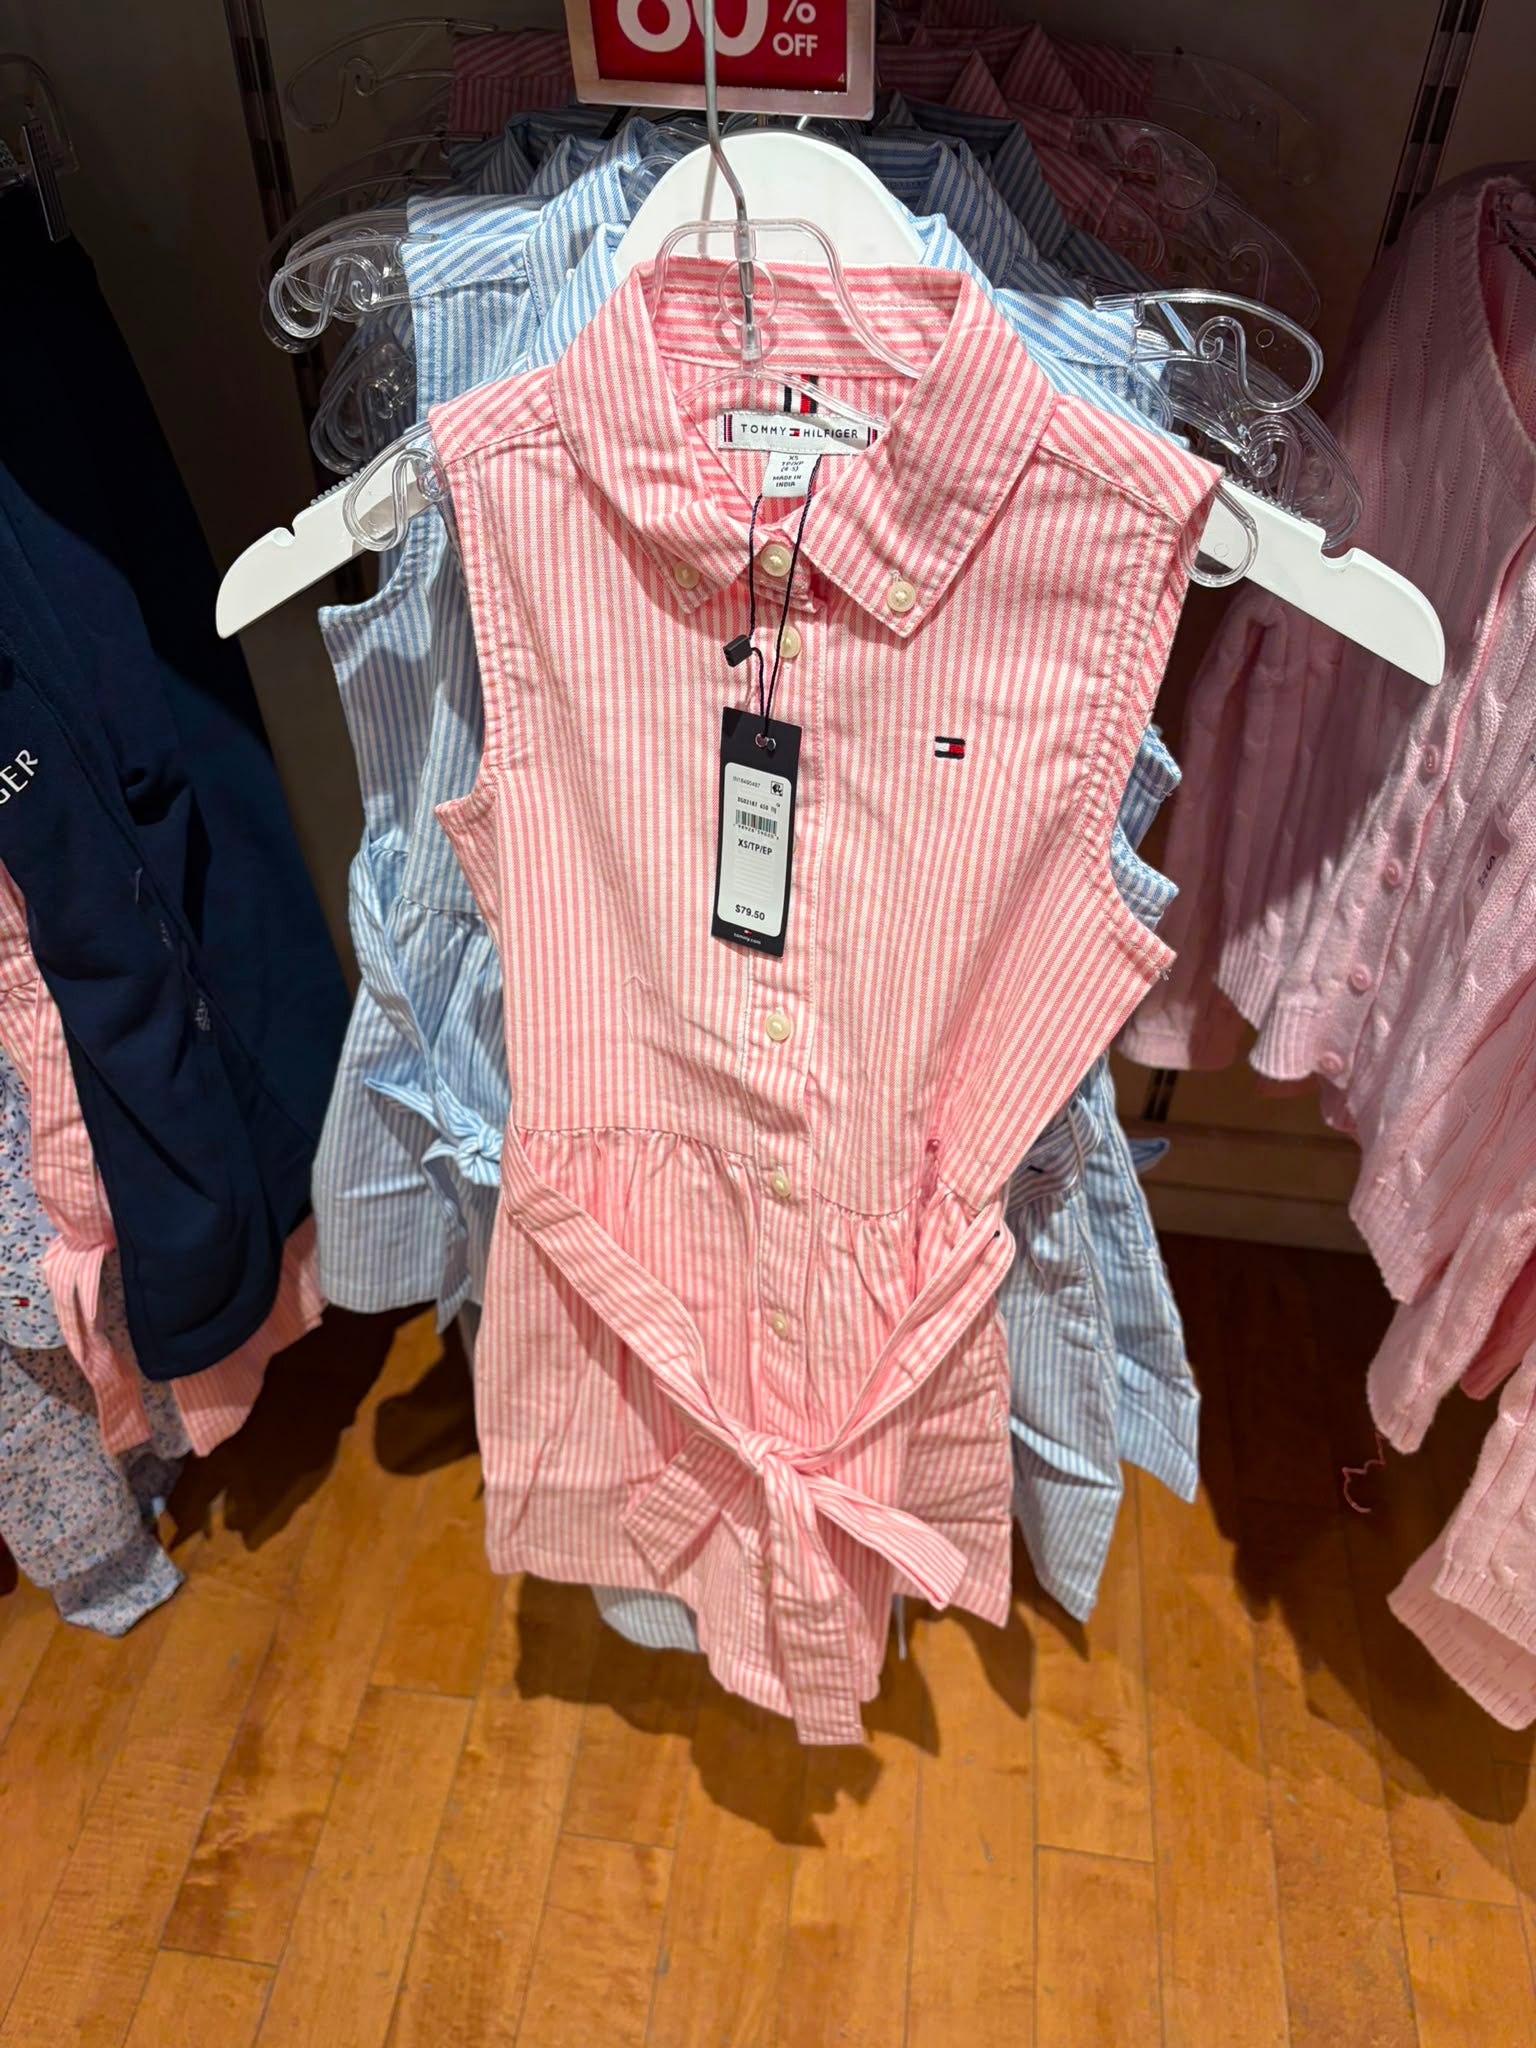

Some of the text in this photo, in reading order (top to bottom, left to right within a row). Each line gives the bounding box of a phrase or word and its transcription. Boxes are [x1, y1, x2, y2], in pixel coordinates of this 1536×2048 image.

[772, 32, 819, 57] OFF
[740, 423, 858, 439] TOMMY HILFIGER
[738, 838, 773, 855] XS/TP/EP
[735, 904, 766, 921] $79.50
